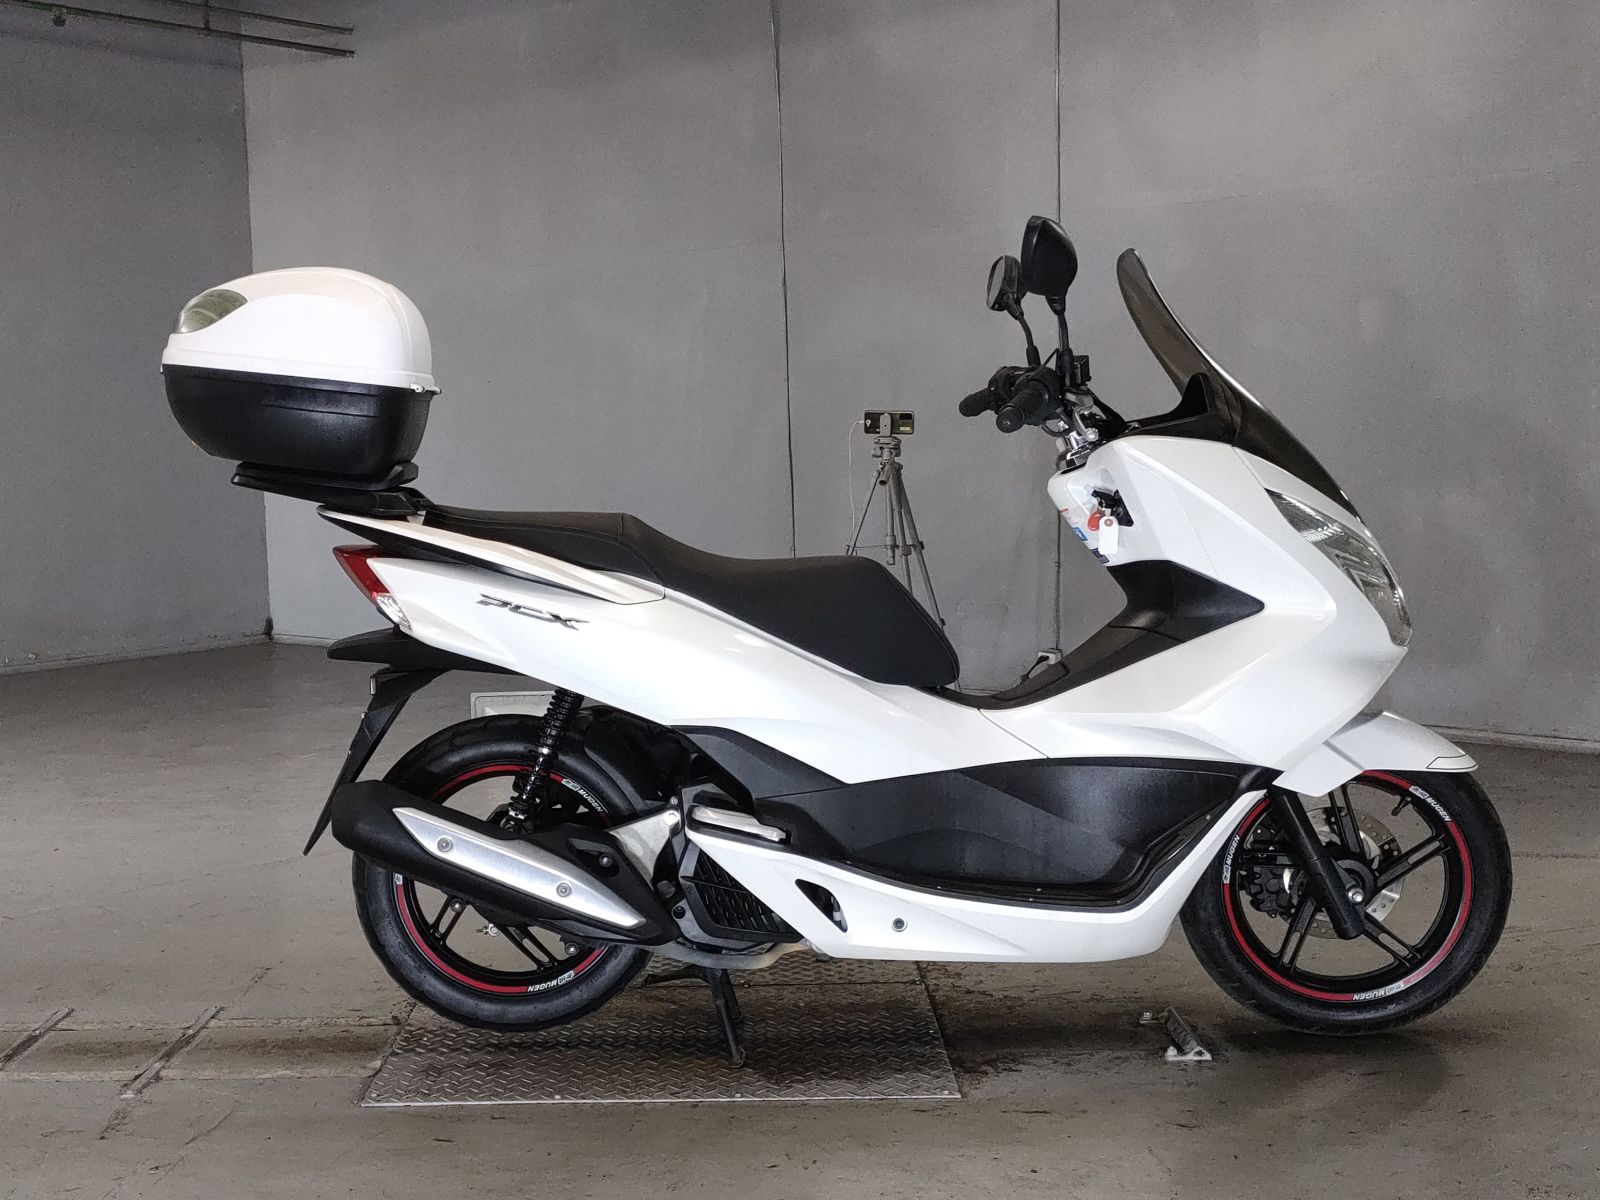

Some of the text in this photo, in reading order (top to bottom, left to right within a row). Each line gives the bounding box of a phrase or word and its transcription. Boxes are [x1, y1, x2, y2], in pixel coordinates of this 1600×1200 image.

[476, 593, 591, 631] PCX
[577, 789, 603, 812] MUGEN
[1425, 797, 1451, 821] MUGEN
[1226, 834, 1240, 866] MUGEN
[528, 979, 558, 992] MUGEN
[1353, 989, 1385, 1000] MUGEN
